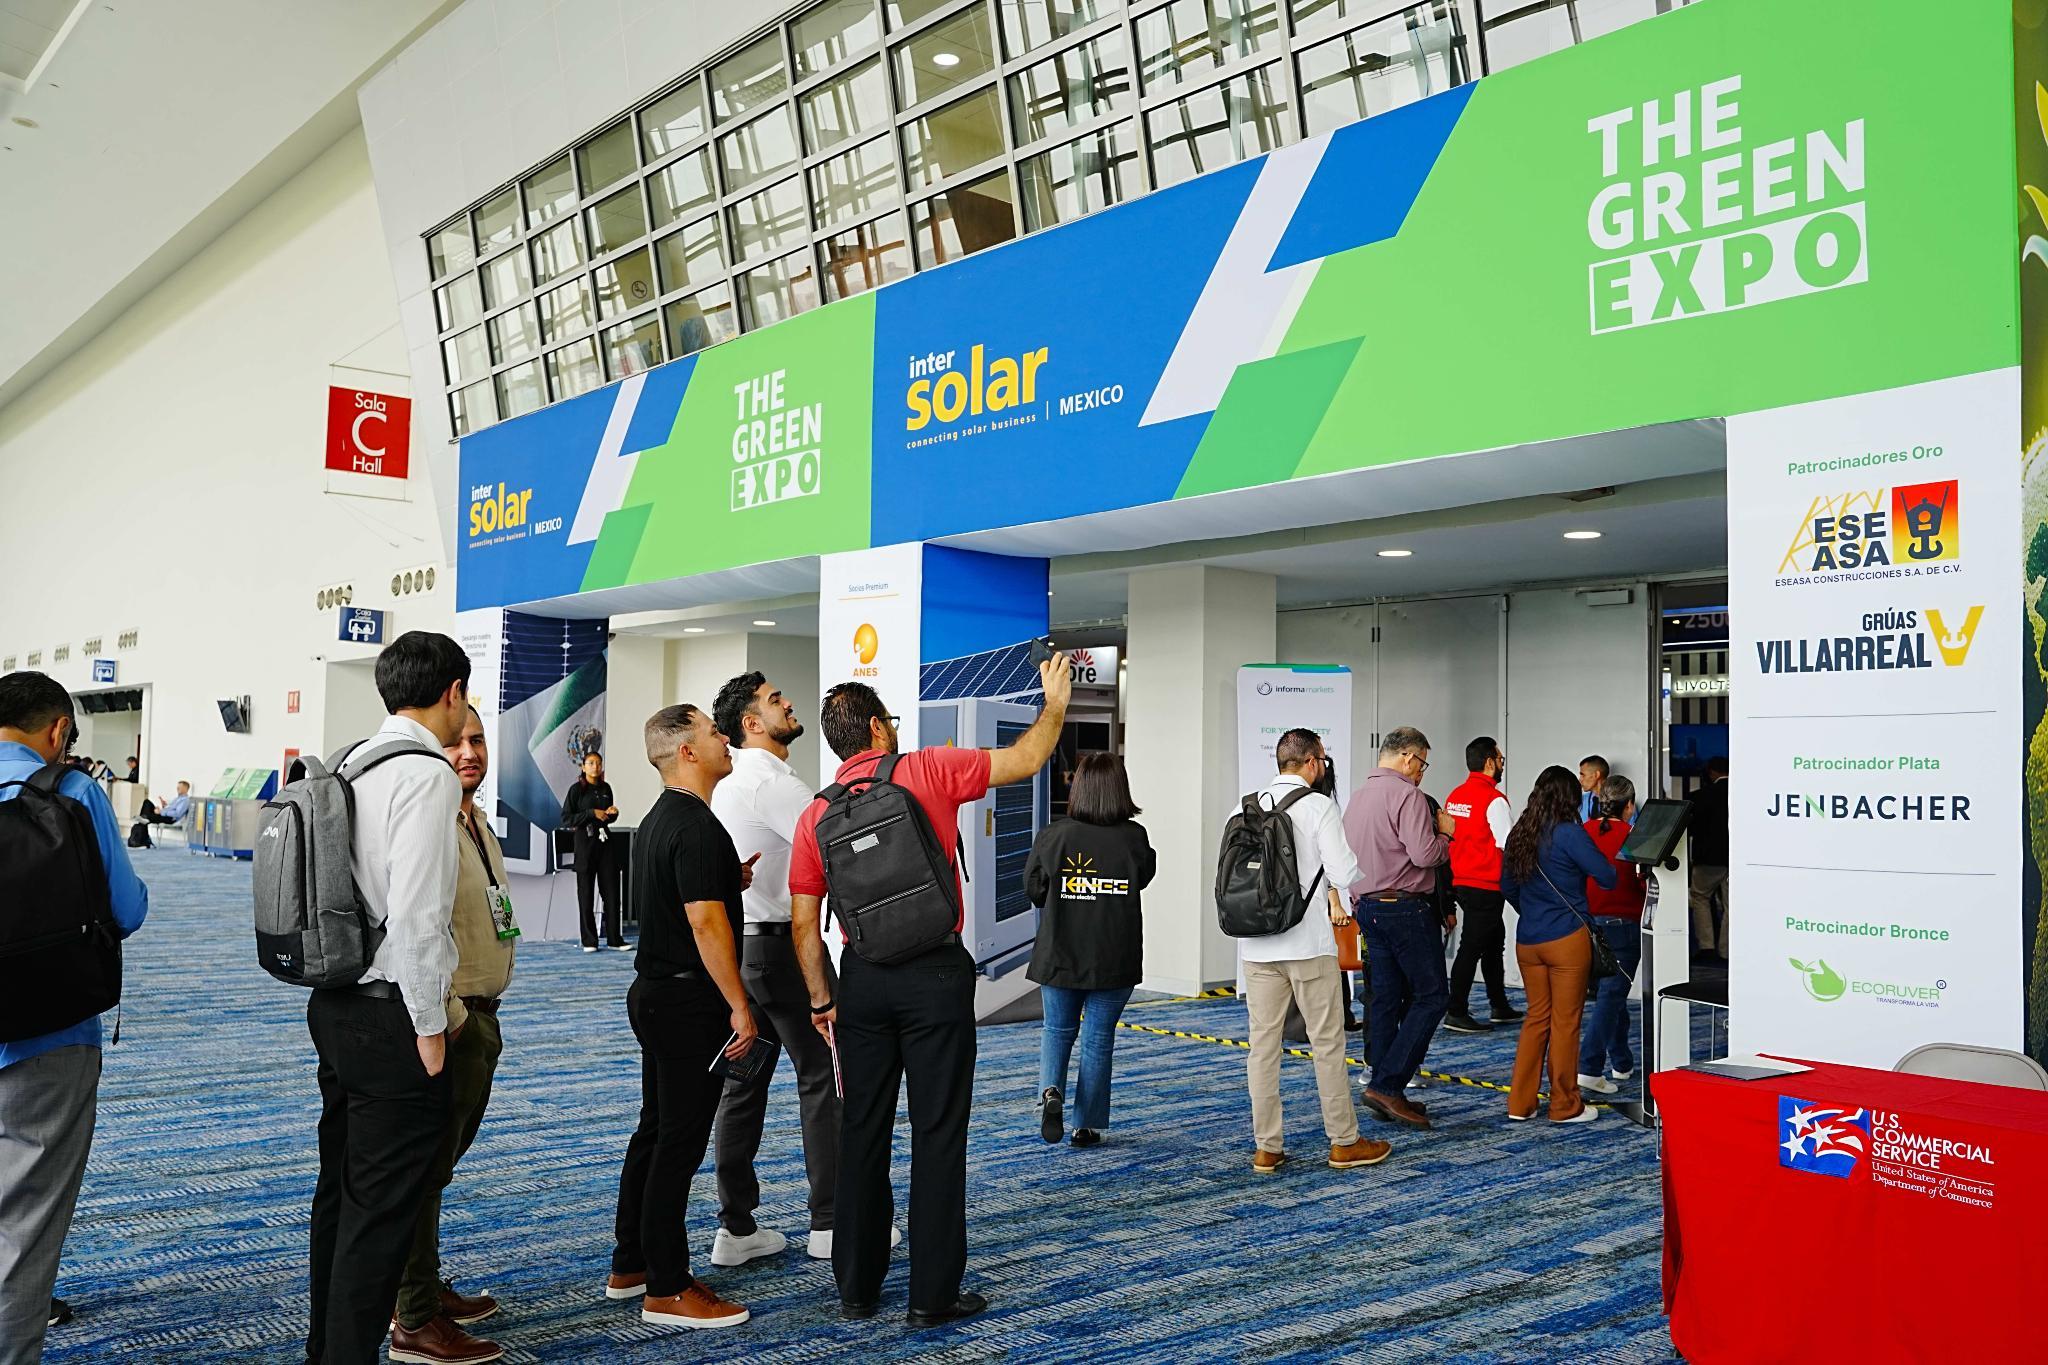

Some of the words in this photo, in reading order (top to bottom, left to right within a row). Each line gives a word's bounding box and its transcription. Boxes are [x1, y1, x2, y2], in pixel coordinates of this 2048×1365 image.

[1587, 74, 1742, 178] THE
[1587, 117, 1866, 250] GREEN
[1592, 209, 1864, 332] EXPO
[909, 350, 956, 379] inter
[354, 392, 386, 412] Sala
[734, 368, 786, 421] THE
[906, 343, 1049, 431] solar
[1059, 384, 1124, 416] MEXICO
[351, 410, 387, 457] C
[732, 402, 822, 464] GREEN
[906, 430, 958, 450] connecting
[962, 424, 987, 437] solar
[991, 414, 1037, 431] business
[352, 454, 382, 474] Hall
[1788, 448, 1908, 476] Patrocinadores
[1911, 444, 1944, 461] Oro
[471, 484, 493, 502] inter
[733, 450, 820, 511] EXPO
[469, 481, 533, 537] solar
[534, 516, 563, 535] MEXICO
[1813, 511, 1887, 544] ESE
[1811, 540, 1891, 573] ASA
[848, 584, 864, 592] Socios
[865, 582, 889, 591] Premium
[1775, 576, 1812, 587] ESEASA
[1813, 569, 1902, 585] CONSTRUCCIONES
[1905, 568, 1923, 577] S.A.
[1926, 566, 1941, 575] DE
[1943, 564, 1962, 574] C.V.
[1684, 613, 1729, 629] 250
[1862, 607, 1917, 632] GRÚAS
[1756, 632, 1932, 674] VILLARREAL
[853, 667, 878, 677] ANES
[1675, 680, 1729, 691] LIVOLT
[1793, 756, 1894, 770] Patrocinador
[1898, 756, 1941, 770] Plata
[1767, 793, 1971, 822] JENBACHER
[1785, 916, 1886, 937] Patrocinador
[1890, 924, 1950, 941] Bronce
[1852, 981, 1940, 1000] ECORUVER
[1876, 997, 1916, 1006] TRANSFORMA
[1871, 1109, 1903, 1130] U.S.
[1871, 1141, 1940, 1169] SERVICE
[1872, 1127, 1995, 1165] COMMERCIAL
[1872, 1161, 1904, 1178] United
[1906, 1169, 1936, 1184] States
[1938, 1176, 1950, 1188] of
[1949, 1179, 1994, 1197] America
[1872, 1172, 1927, 1194] Department
[1928, 1186, 1940, 1199] of
[1939, 1187, 1993, 1209] Commerce
